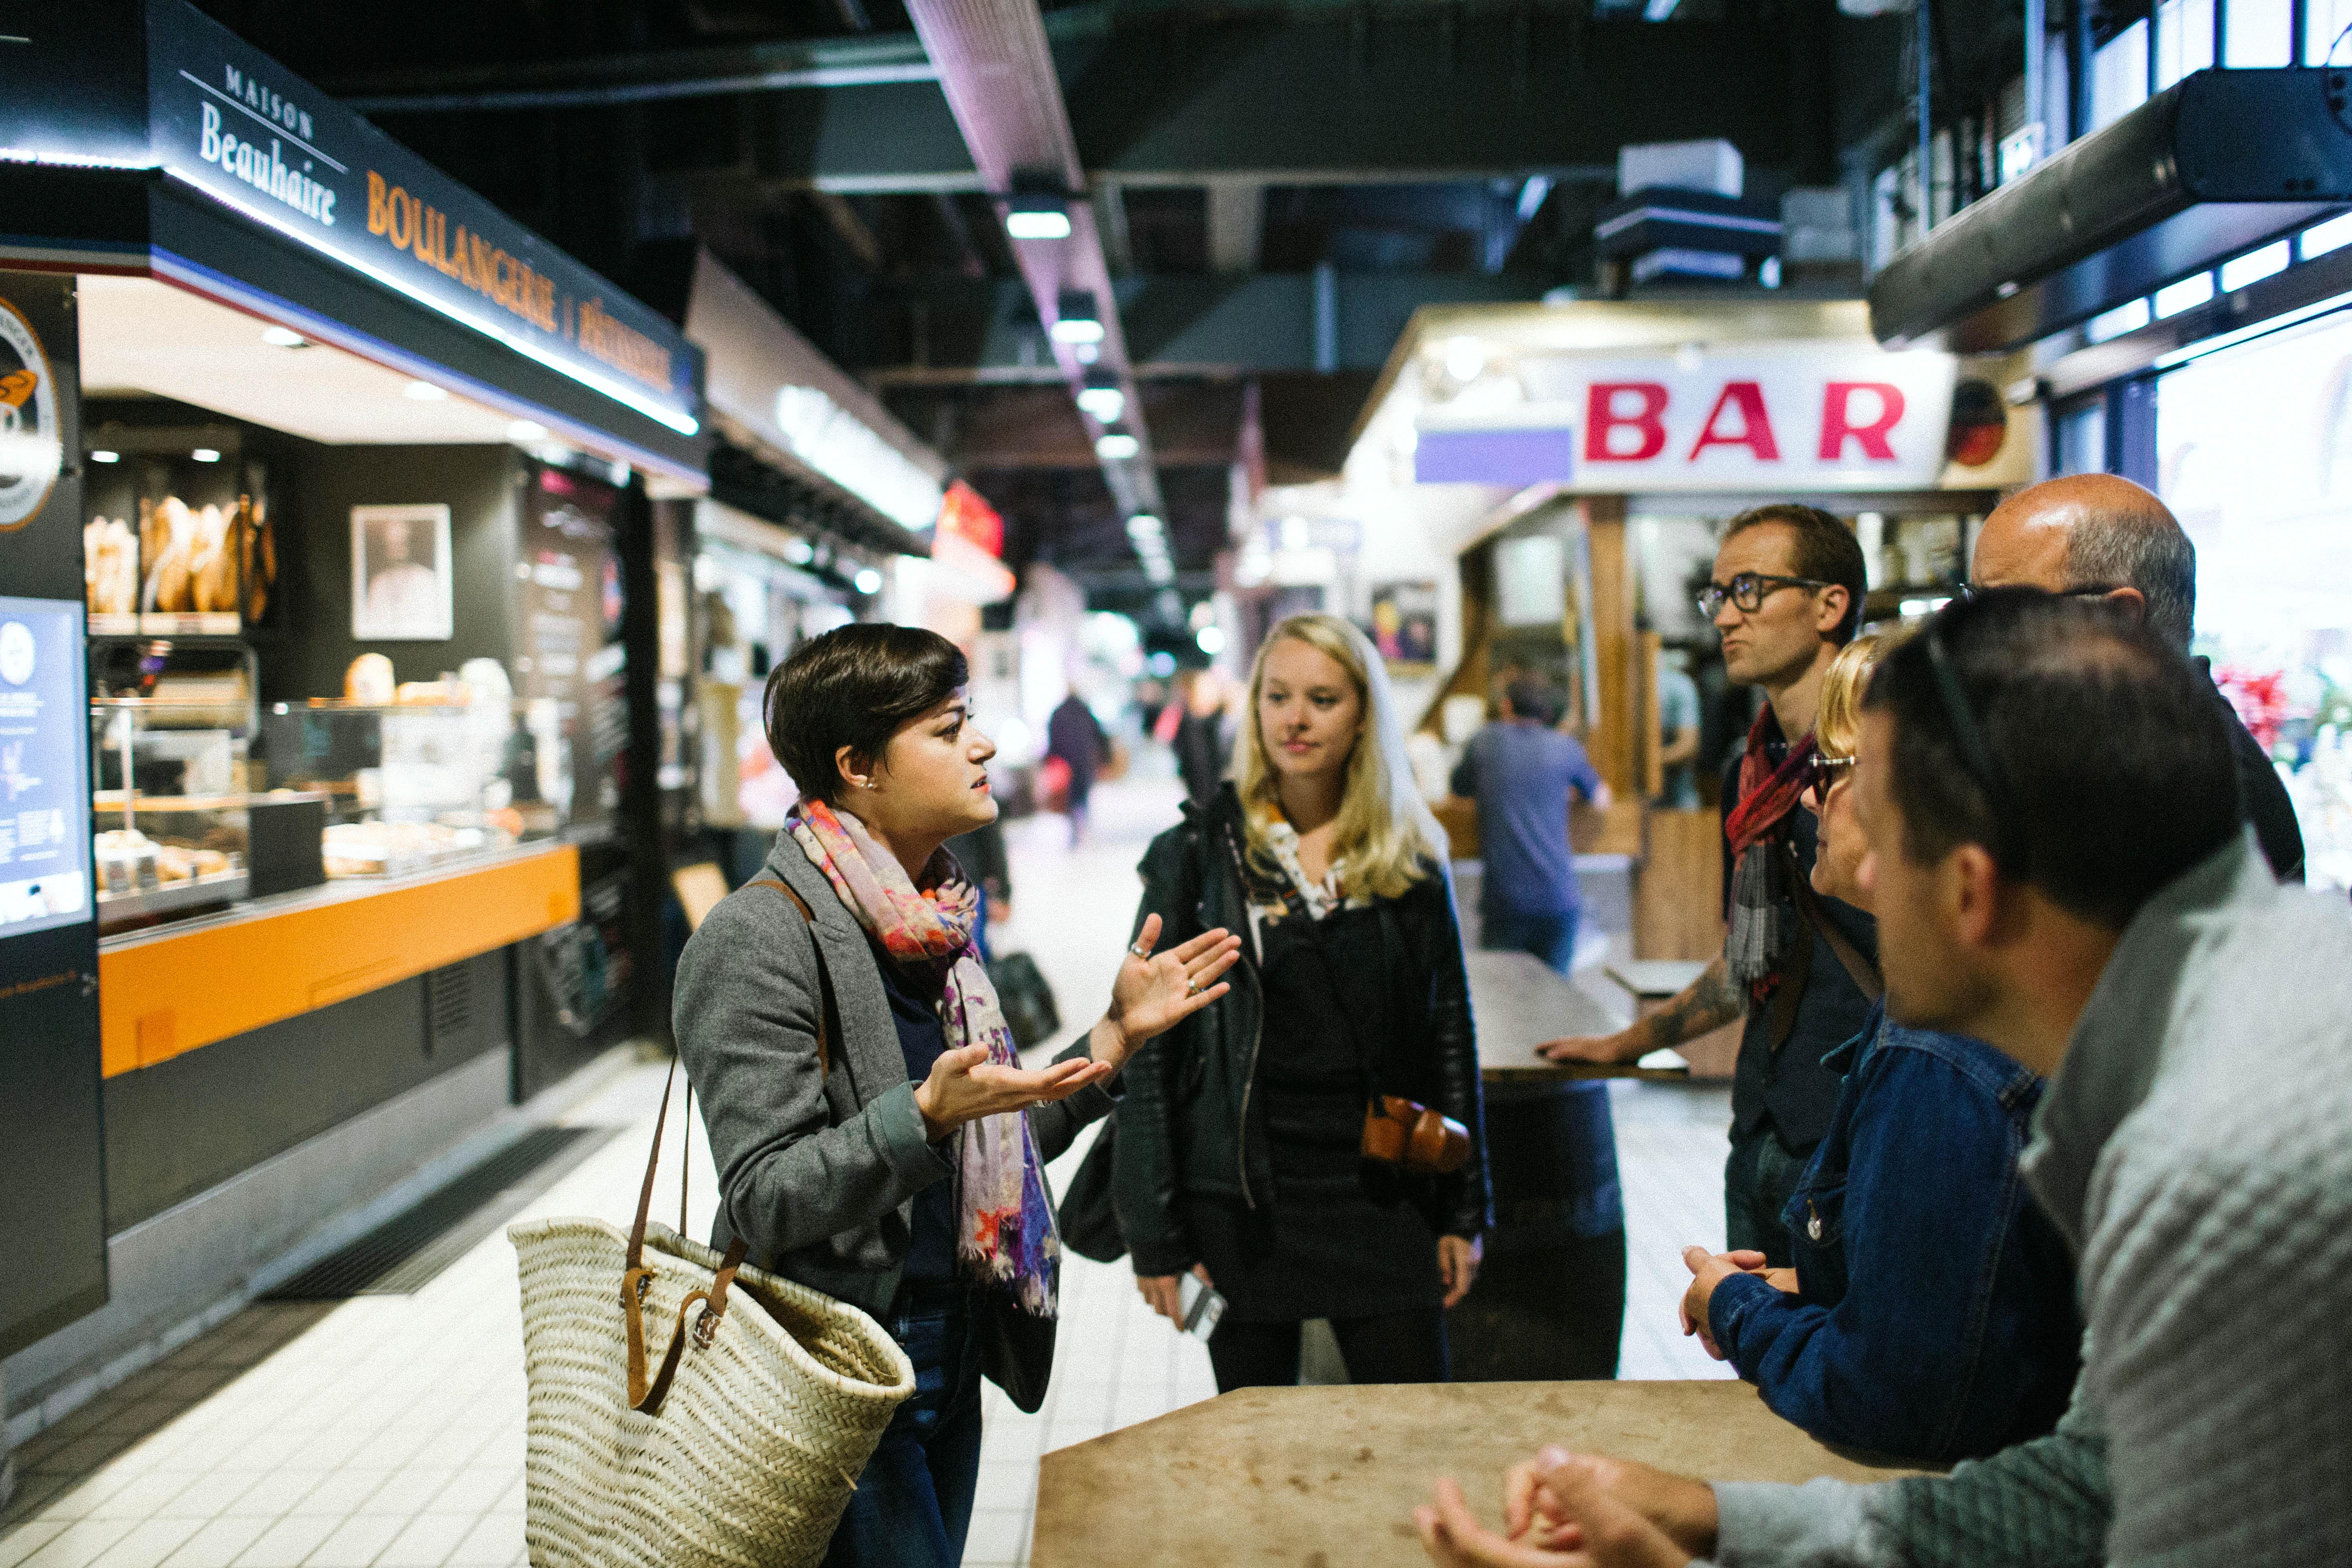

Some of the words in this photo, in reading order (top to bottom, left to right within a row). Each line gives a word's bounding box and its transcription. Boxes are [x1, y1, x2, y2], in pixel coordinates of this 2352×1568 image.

[225, 64, 315, 141] MAISON
[200, 100, 337, 227] Beauhaire
[367, 169, 558, 333] BOULANGERIE
[1585, 381, 1906, 462] BAR
